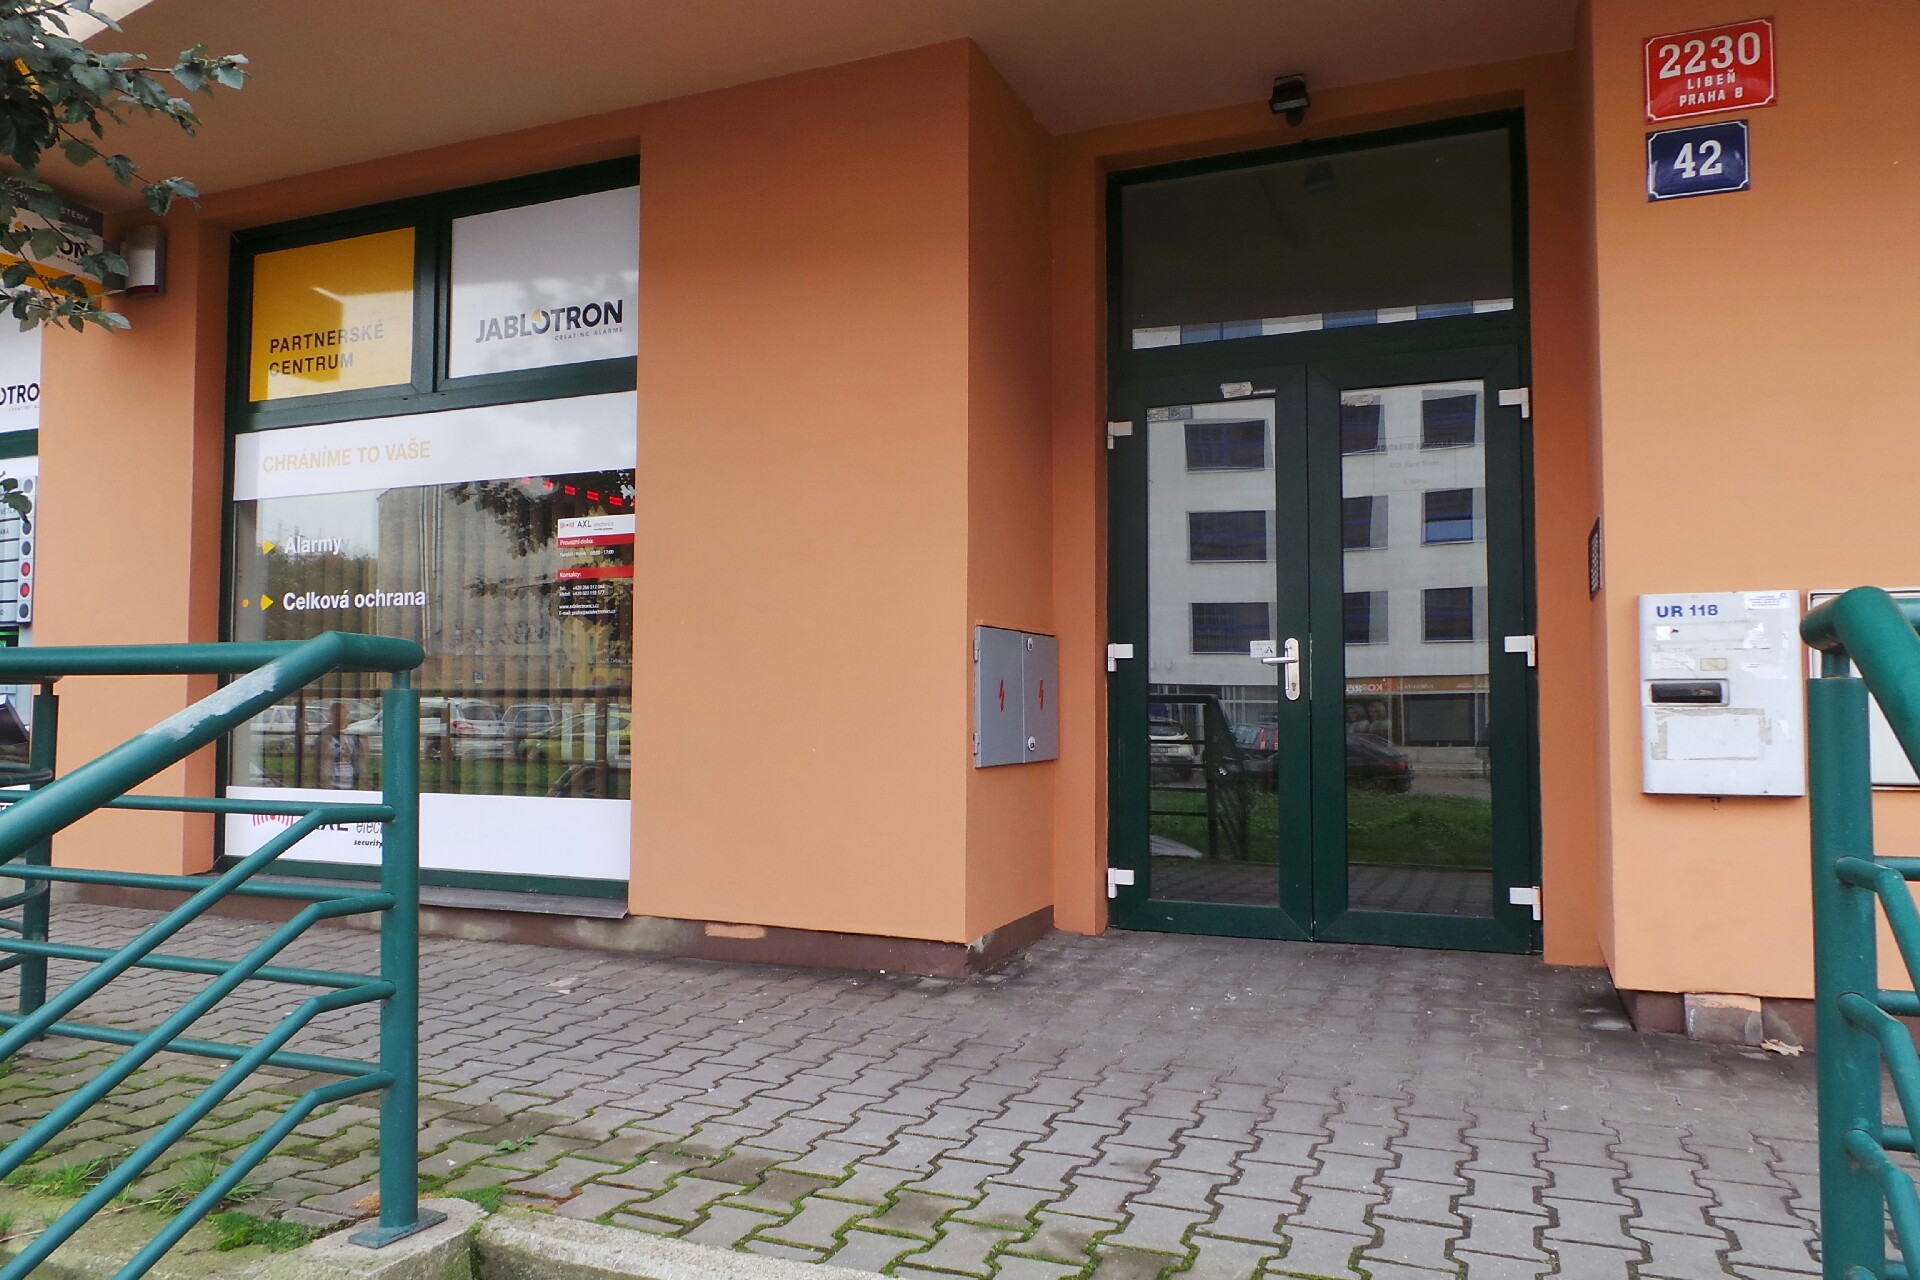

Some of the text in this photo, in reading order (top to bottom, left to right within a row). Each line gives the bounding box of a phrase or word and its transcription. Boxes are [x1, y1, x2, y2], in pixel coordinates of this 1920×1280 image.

[1659, 32, 1760, 79] 2230
[1688, 69, 1736, 90] LIBEŇ
[1680, 90, 1726, 107] PRAHA
[1674, 140, 1723, 179] 42
[475, 299, 623, 343] JABLOTRON
[593, 326, 623, 337] ALARMS
[269, 319, 385, 354] PARTNERSKÉ
[269, 352, 354, 377] CENTRUM
[262, 437, 431, 473] CHRÁNÍME TO VAŠE
[577, 520, 592, 528] AXL
[284, 535, 343, 556] Alarmy
[283, 588, 427, 611] Celková ochrana
[1656, 604, 1719, 618] UR 118
